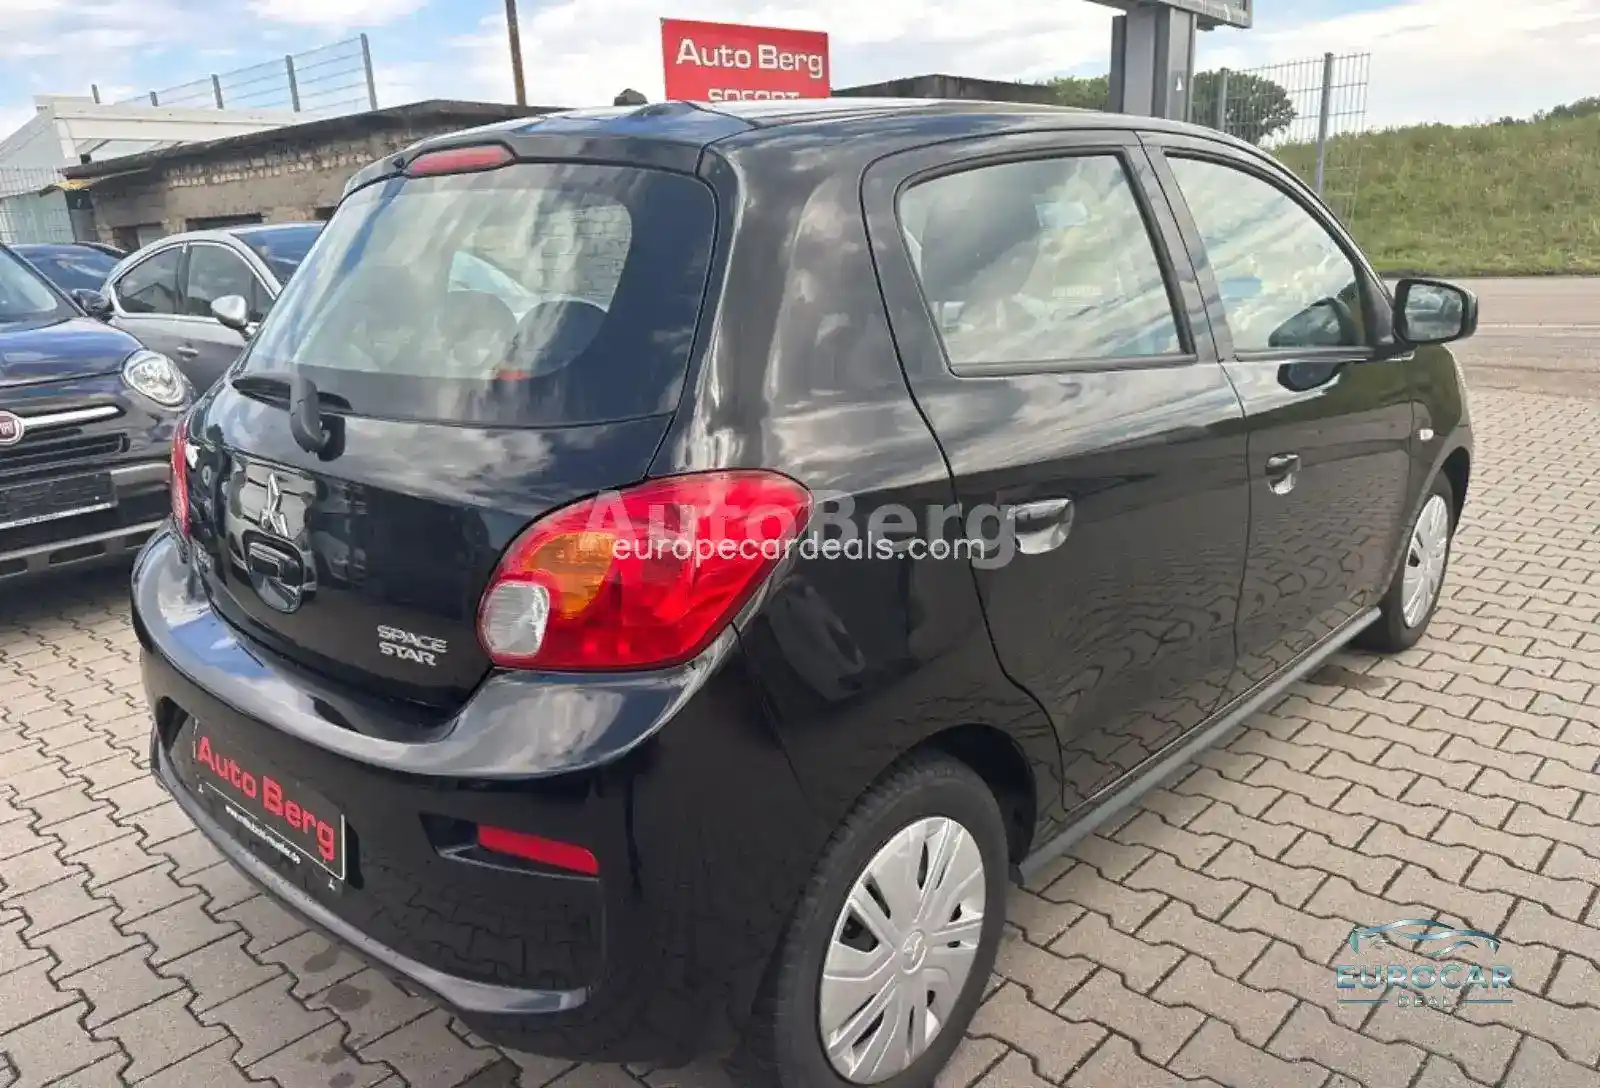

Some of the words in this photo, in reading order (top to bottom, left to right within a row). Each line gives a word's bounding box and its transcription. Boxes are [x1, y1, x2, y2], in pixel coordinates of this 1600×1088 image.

[676, 38, 751, 68] Auto
[758, 44, 823, 79] Berg
[377, 624, 447, 653] SPACE
[379, 641, 436, 666] STAR
[197, 735, 257, 798] Auto
[262, 775, 335, 861] Berg
